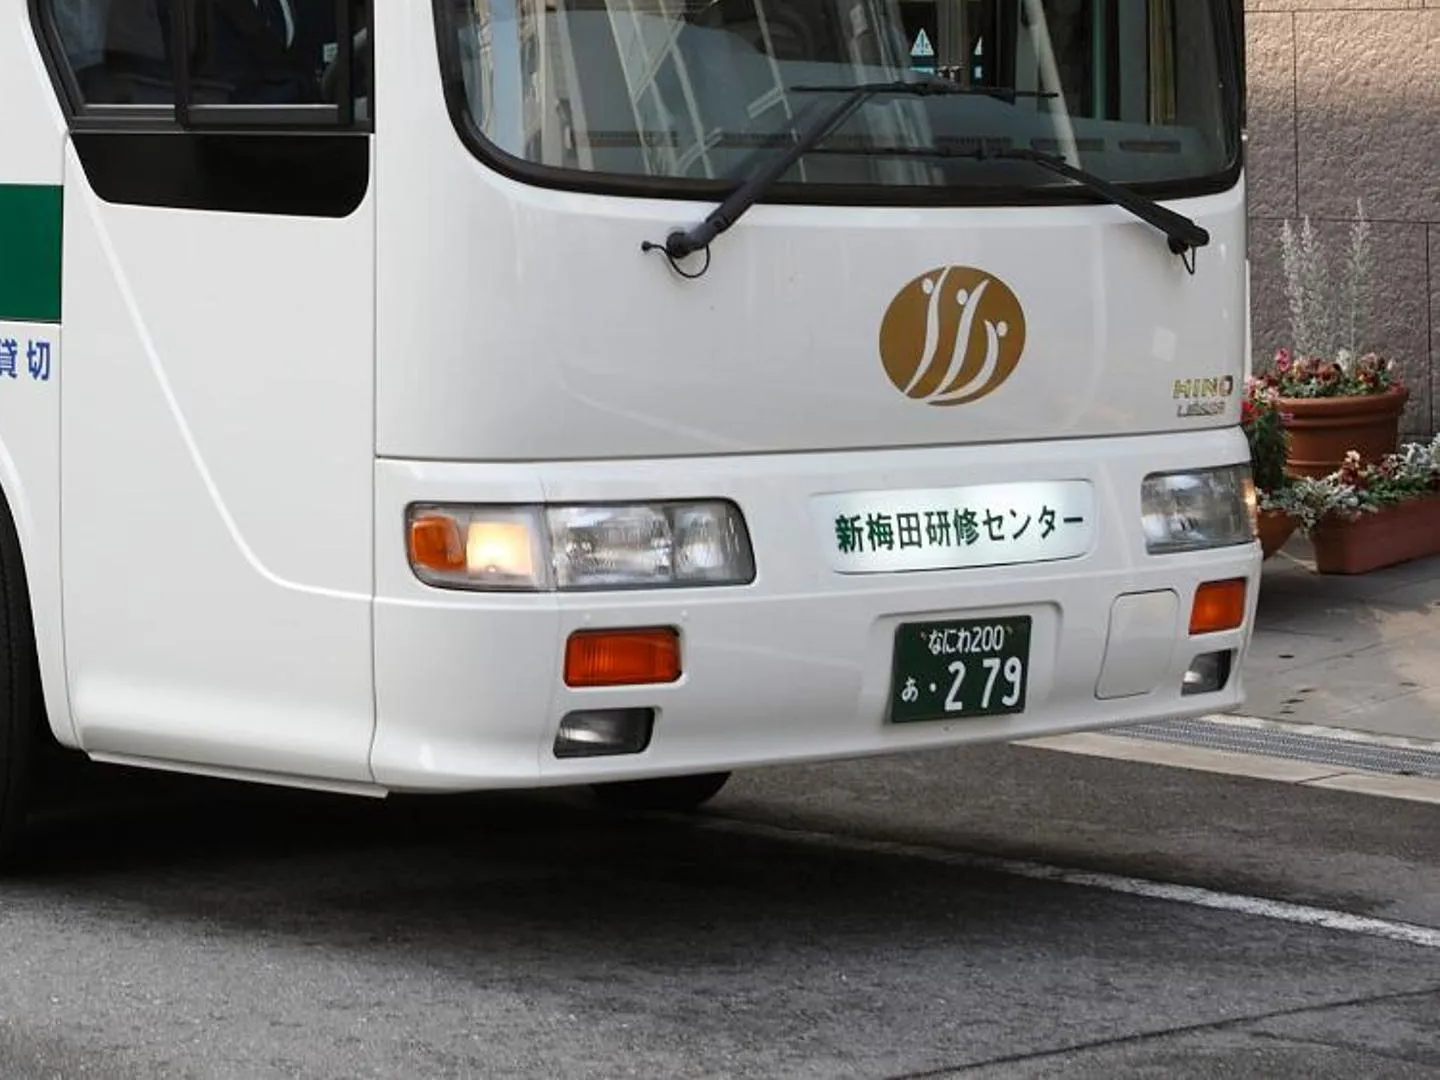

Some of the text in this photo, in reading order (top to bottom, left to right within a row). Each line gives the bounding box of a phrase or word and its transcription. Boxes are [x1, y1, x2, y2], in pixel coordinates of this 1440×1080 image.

[1172, 375, 1234, 399] HINO
[834, 505, 1084, 554] 新梅田研修センター
